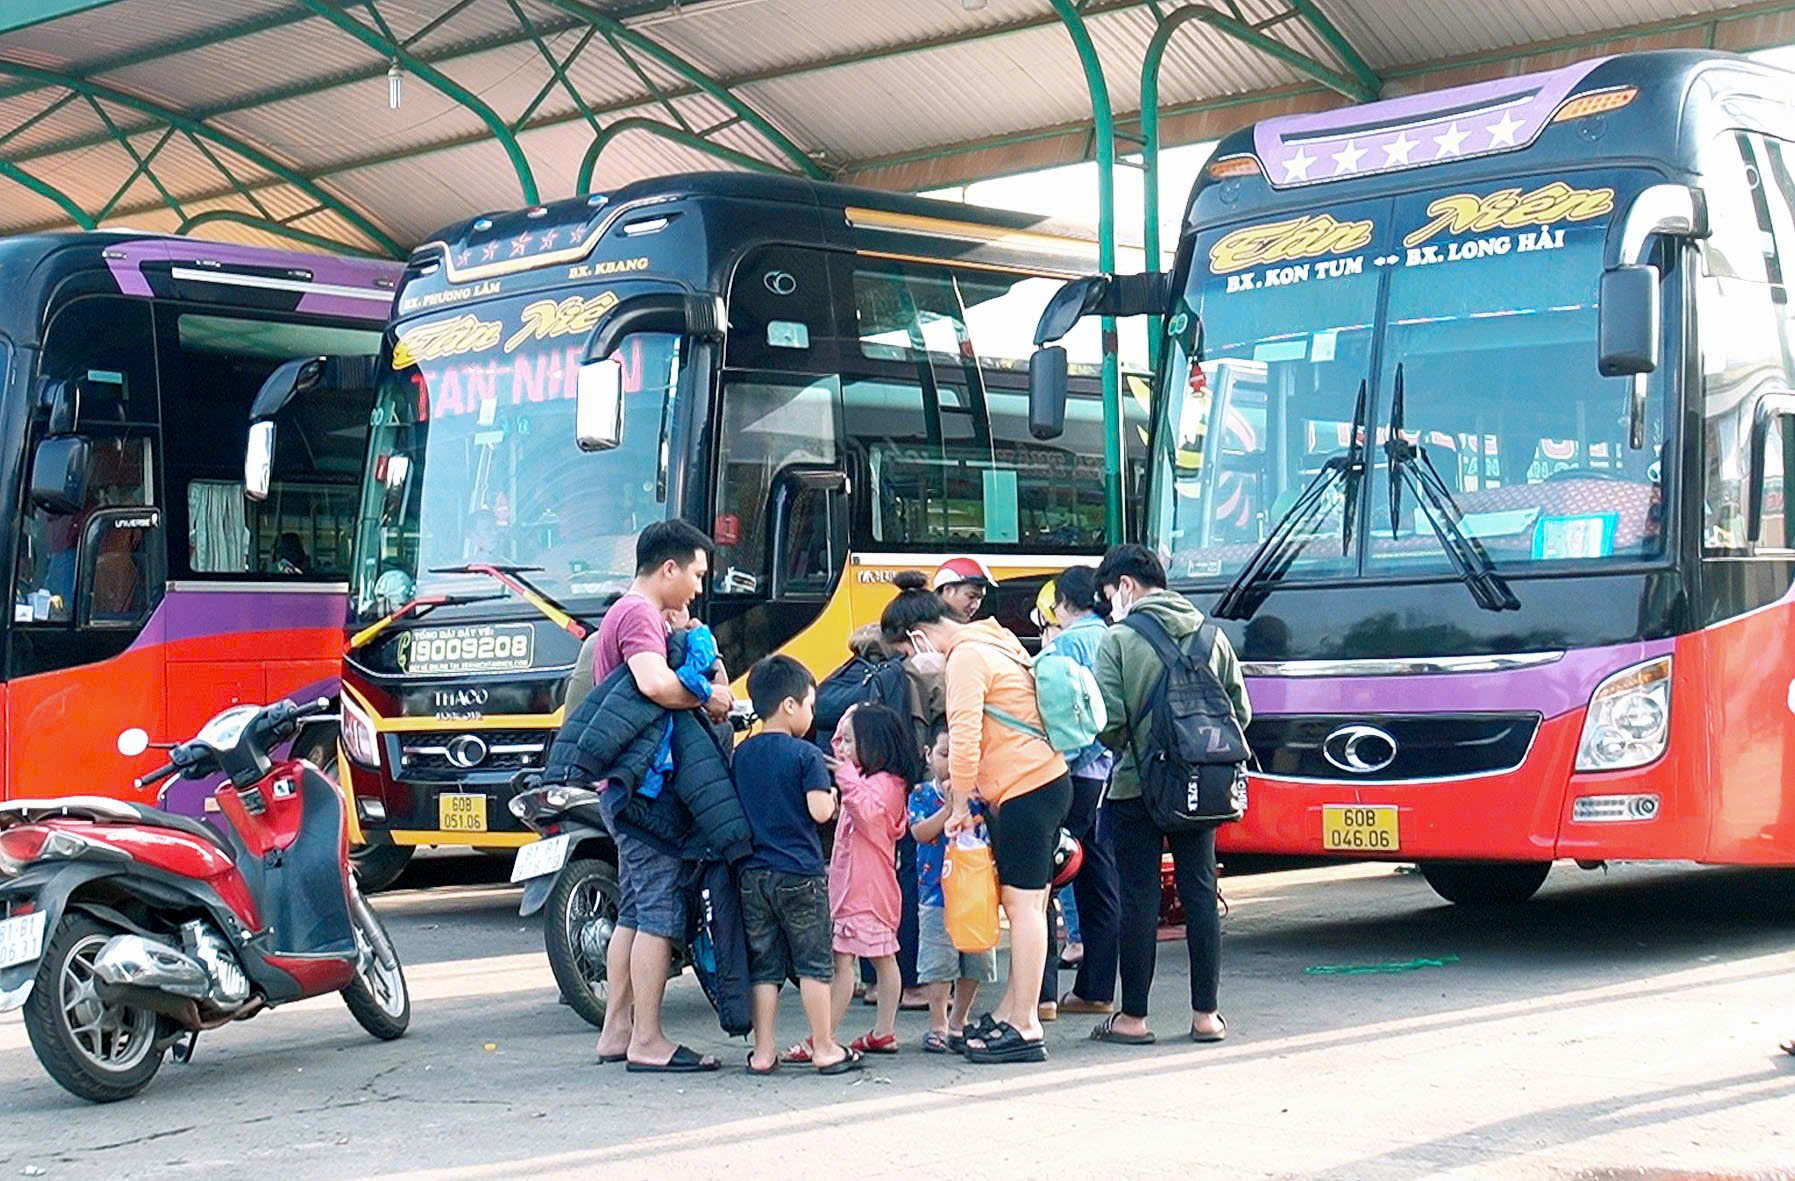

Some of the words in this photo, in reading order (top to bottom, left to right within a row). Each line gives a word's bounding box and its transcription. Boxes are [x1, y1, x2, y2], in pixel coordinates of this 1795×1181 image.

[1225, 275, 1263, 294] BX.
[1265, 263, 1310, 287] KON
[1314, 255, 1364, 280] TUM
[1405, 246, 1444, 267] BX.
[1447, 236, 1512, 262] LONG
[1517, 224, 1565, 253] HẢI
[410, 635, 528, 662] 19009208
[433, 689, 489, 706] THACO
[452, 797, 472, 812] 60B
[1344, 809, 1376, 827] 60B
[1331, 830, 1390, 847] 046.06
